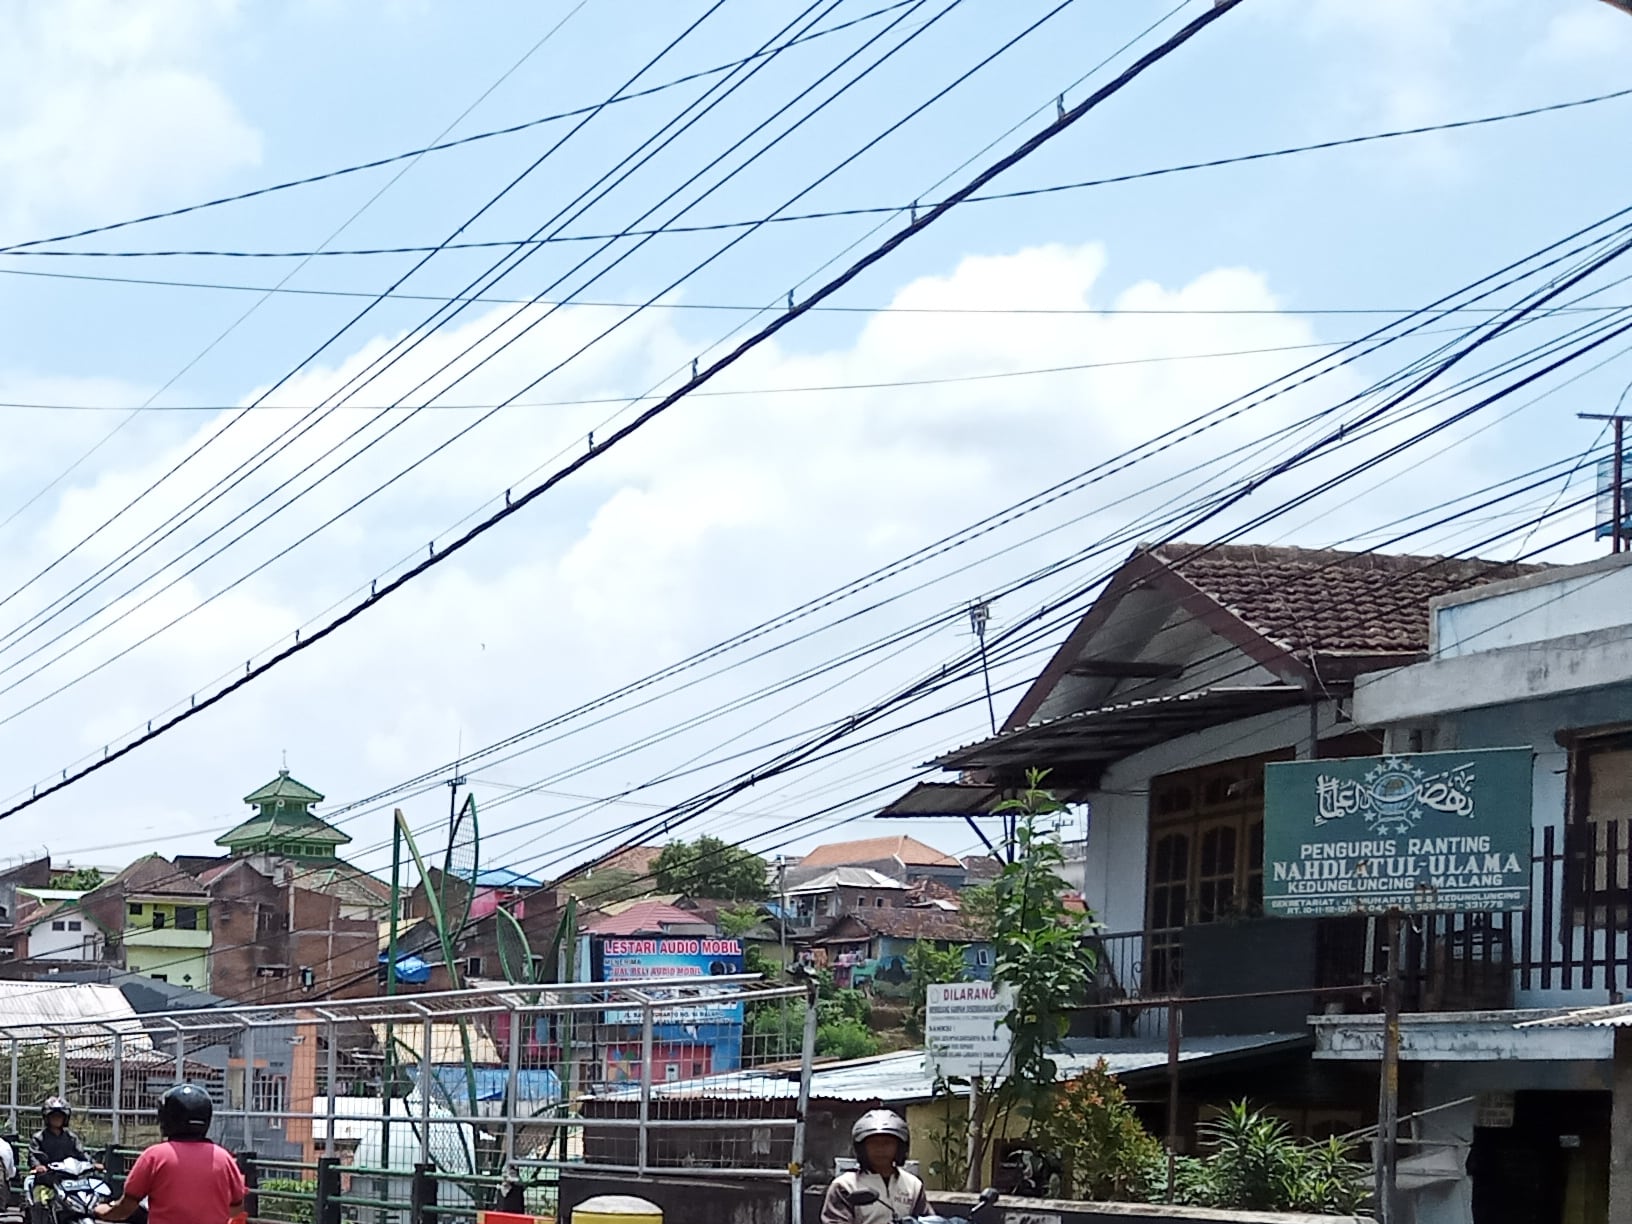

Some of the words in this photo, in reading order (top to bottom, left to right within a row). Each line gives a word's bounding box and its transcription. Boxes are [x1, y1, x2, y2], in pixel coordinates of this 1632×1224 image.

[1300, 840, 1396, 860] PENGURUS
[1408, 836, 1490, 855] RANTING
[1272, 852, 1523, 882] NAHDLATUL-ULAMA
[1288, 876, 1415, 894] KEDUNGLUNCING
[1430, 874, 1503, 889] MALANG
[604, 940, 656, 955] LESTARI
[660, 939, 698, 955] AUDIO
[701, 939, 742, 955] MOBIL
